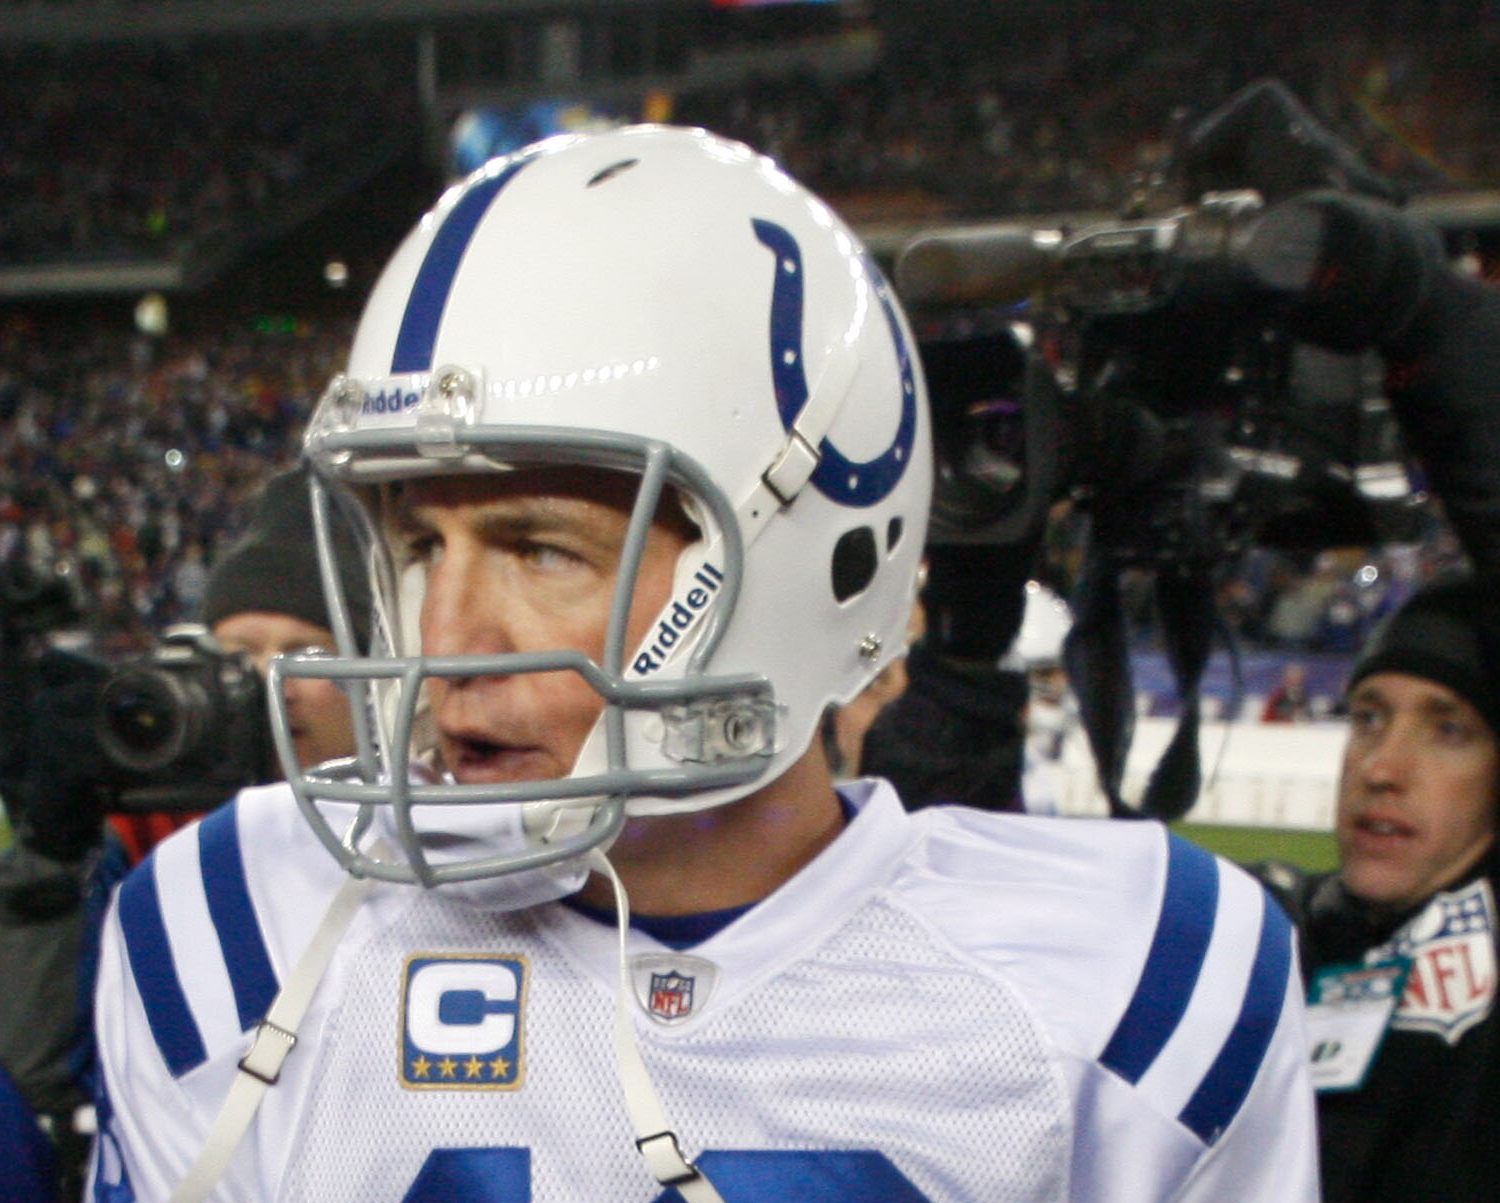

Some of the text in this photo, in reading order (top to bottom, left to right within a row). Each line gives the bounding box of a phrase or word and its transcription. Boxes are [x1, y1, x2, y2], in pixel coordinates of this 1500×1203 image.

[633, 562, 725, 676] Riddell
[407, 961, 518, 1055] C
[652, 989, 691, 1015] NFL
[1397, 943, 1493, 1012] NFL
